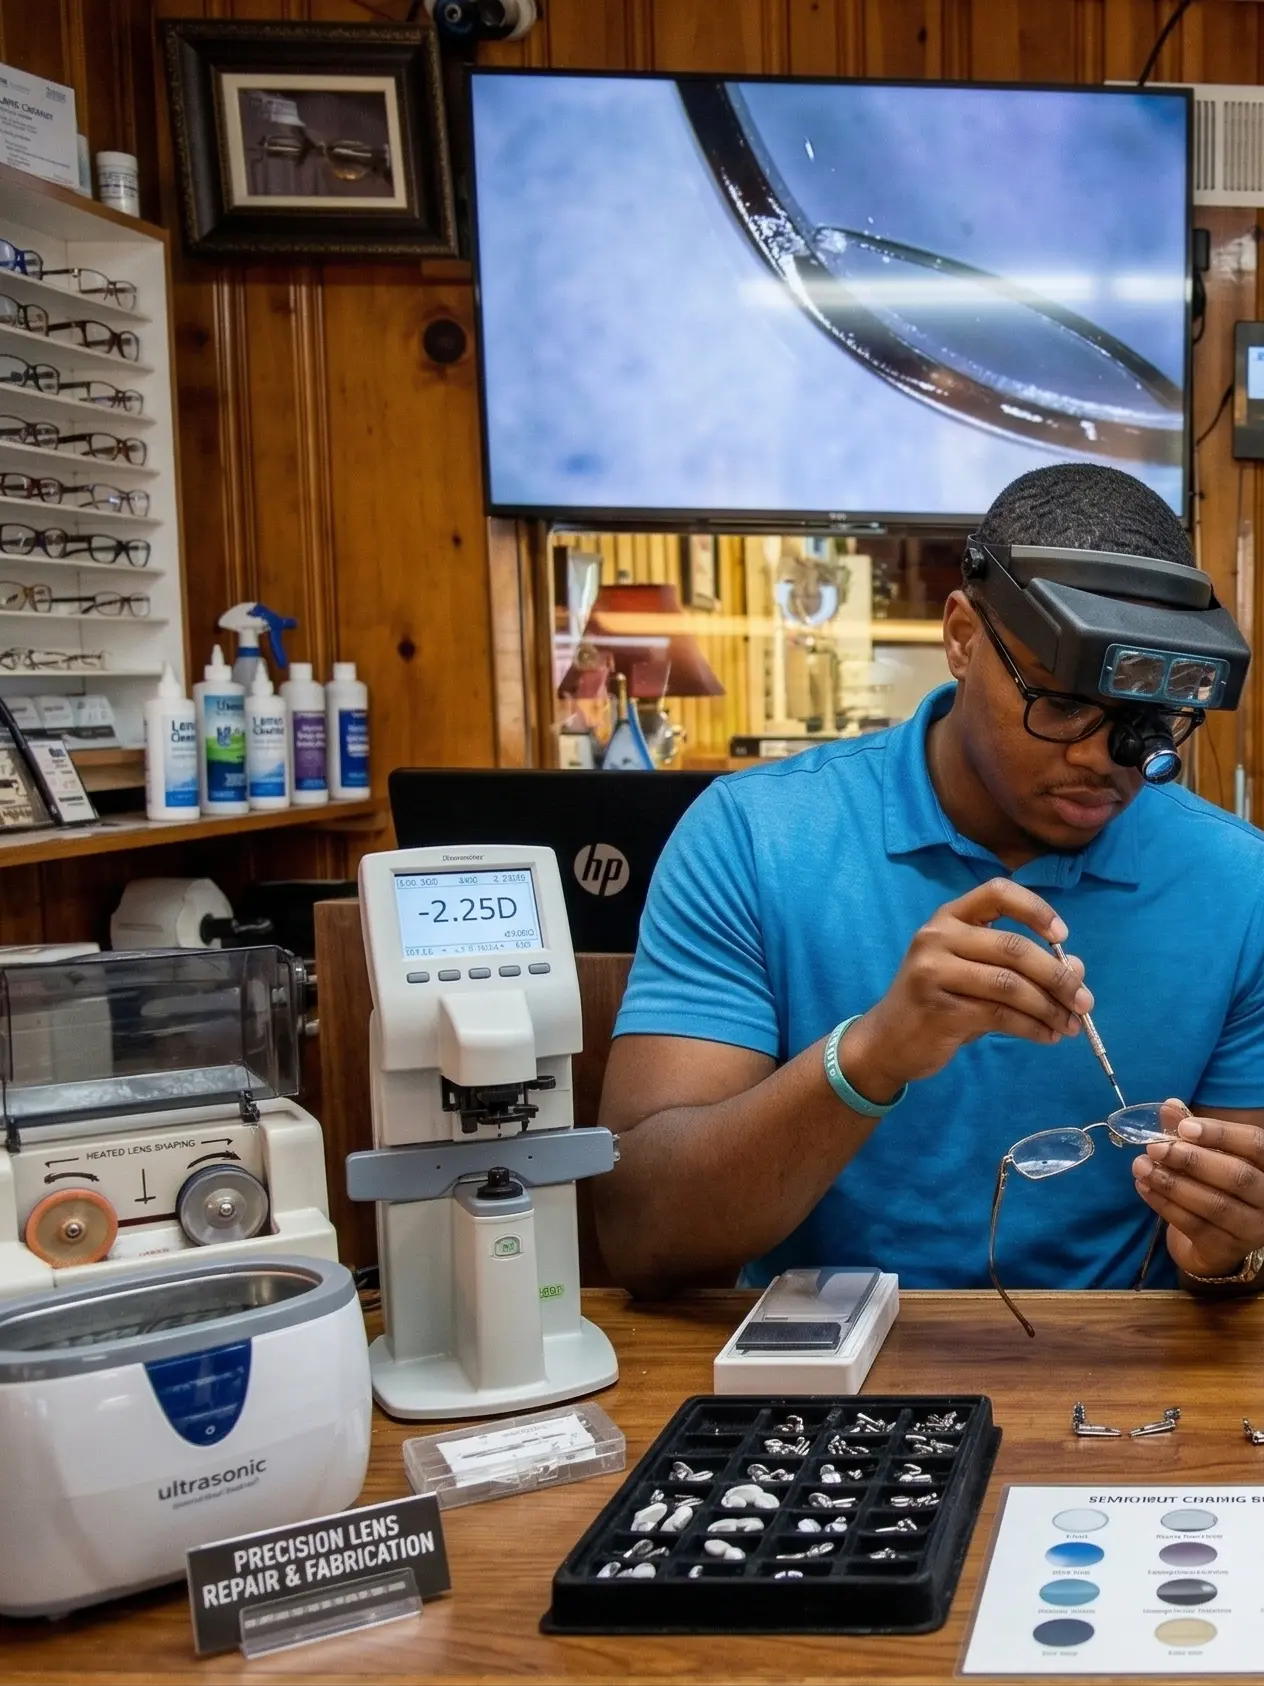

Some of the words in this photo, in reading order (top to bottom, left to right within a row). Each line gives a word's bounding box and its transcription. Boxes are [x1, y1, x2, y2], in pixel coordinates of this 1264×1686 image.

[577, 843, 628, 897] hp
[418, 896, 518, 923] -2.25D
[86, 1148, 126, 1161] HEATED
[128, 1144, 153, 1155] LENS
[158, 1459, 267, 1500] ultrasonic
[233, 1527, 344, 1574] PRECISION
[349, 1514, 400, 1546] LENS
[202, 1569, 280, 1609] REPAIR
[285, 1563, 302, 1588] &
[305, 1531, 435, 1584] FABRICATION
